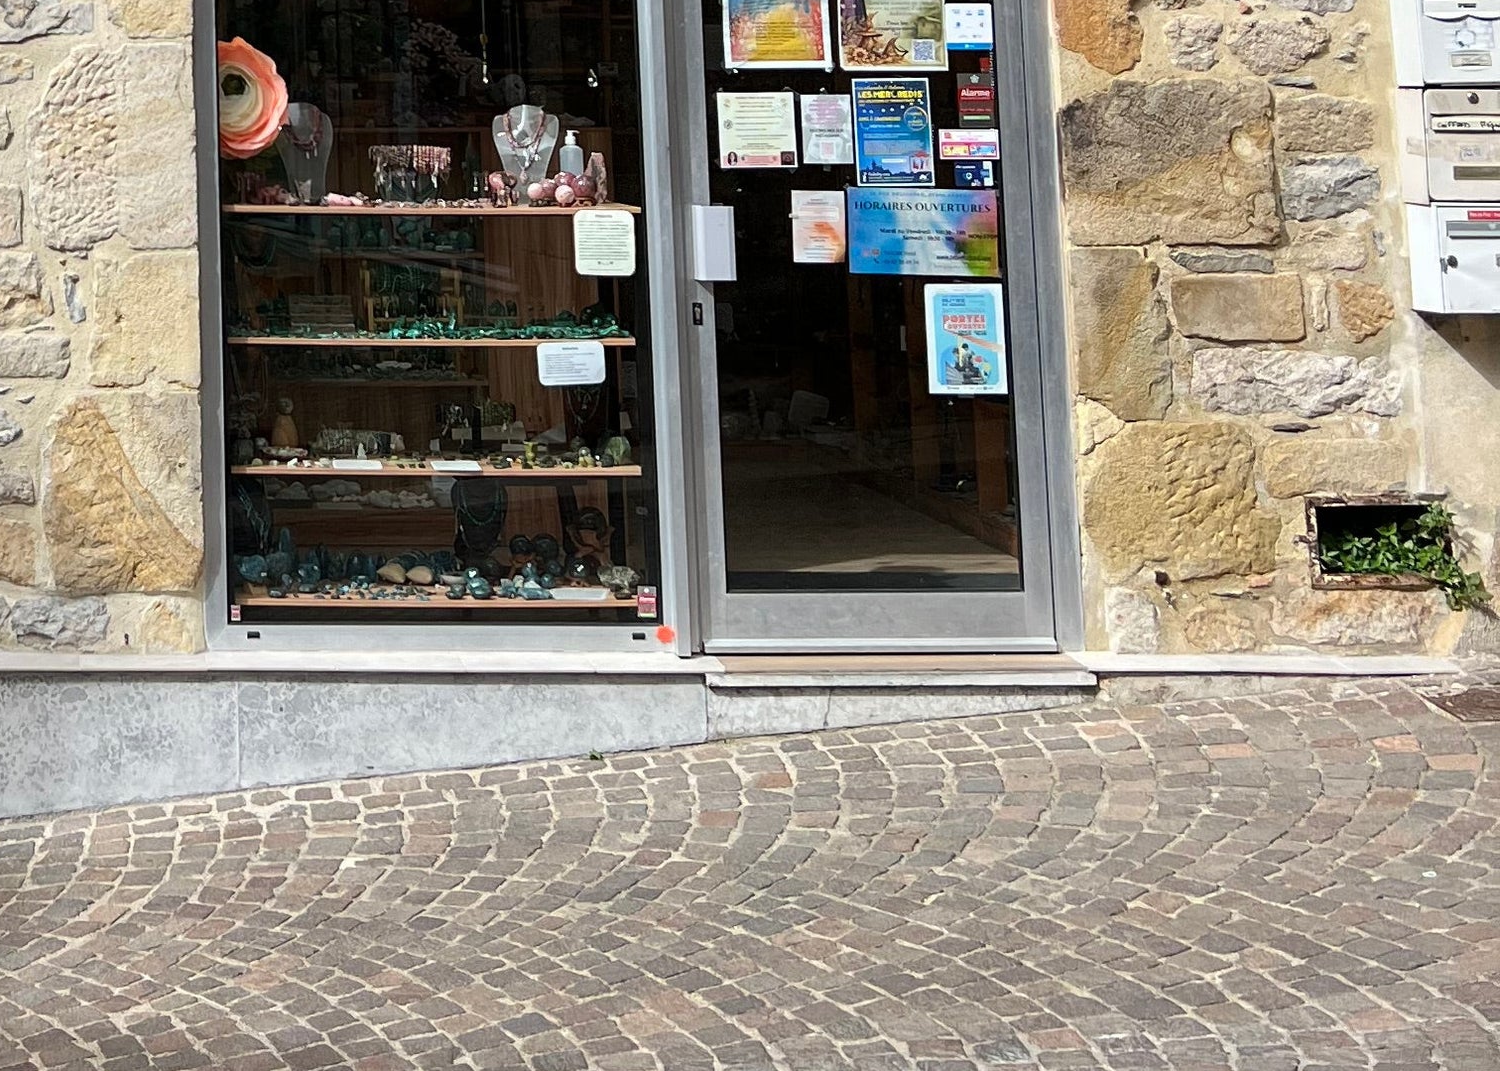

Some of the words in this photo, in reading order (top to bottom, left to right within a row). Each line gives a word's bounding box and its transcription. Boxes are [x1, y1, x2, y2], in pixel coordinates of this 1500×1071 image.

[960, 88, 991, 97] Alarme
[854, 200, 913, 211] HORAIRES
[915, 201, 991, 213] OUVERTURES
